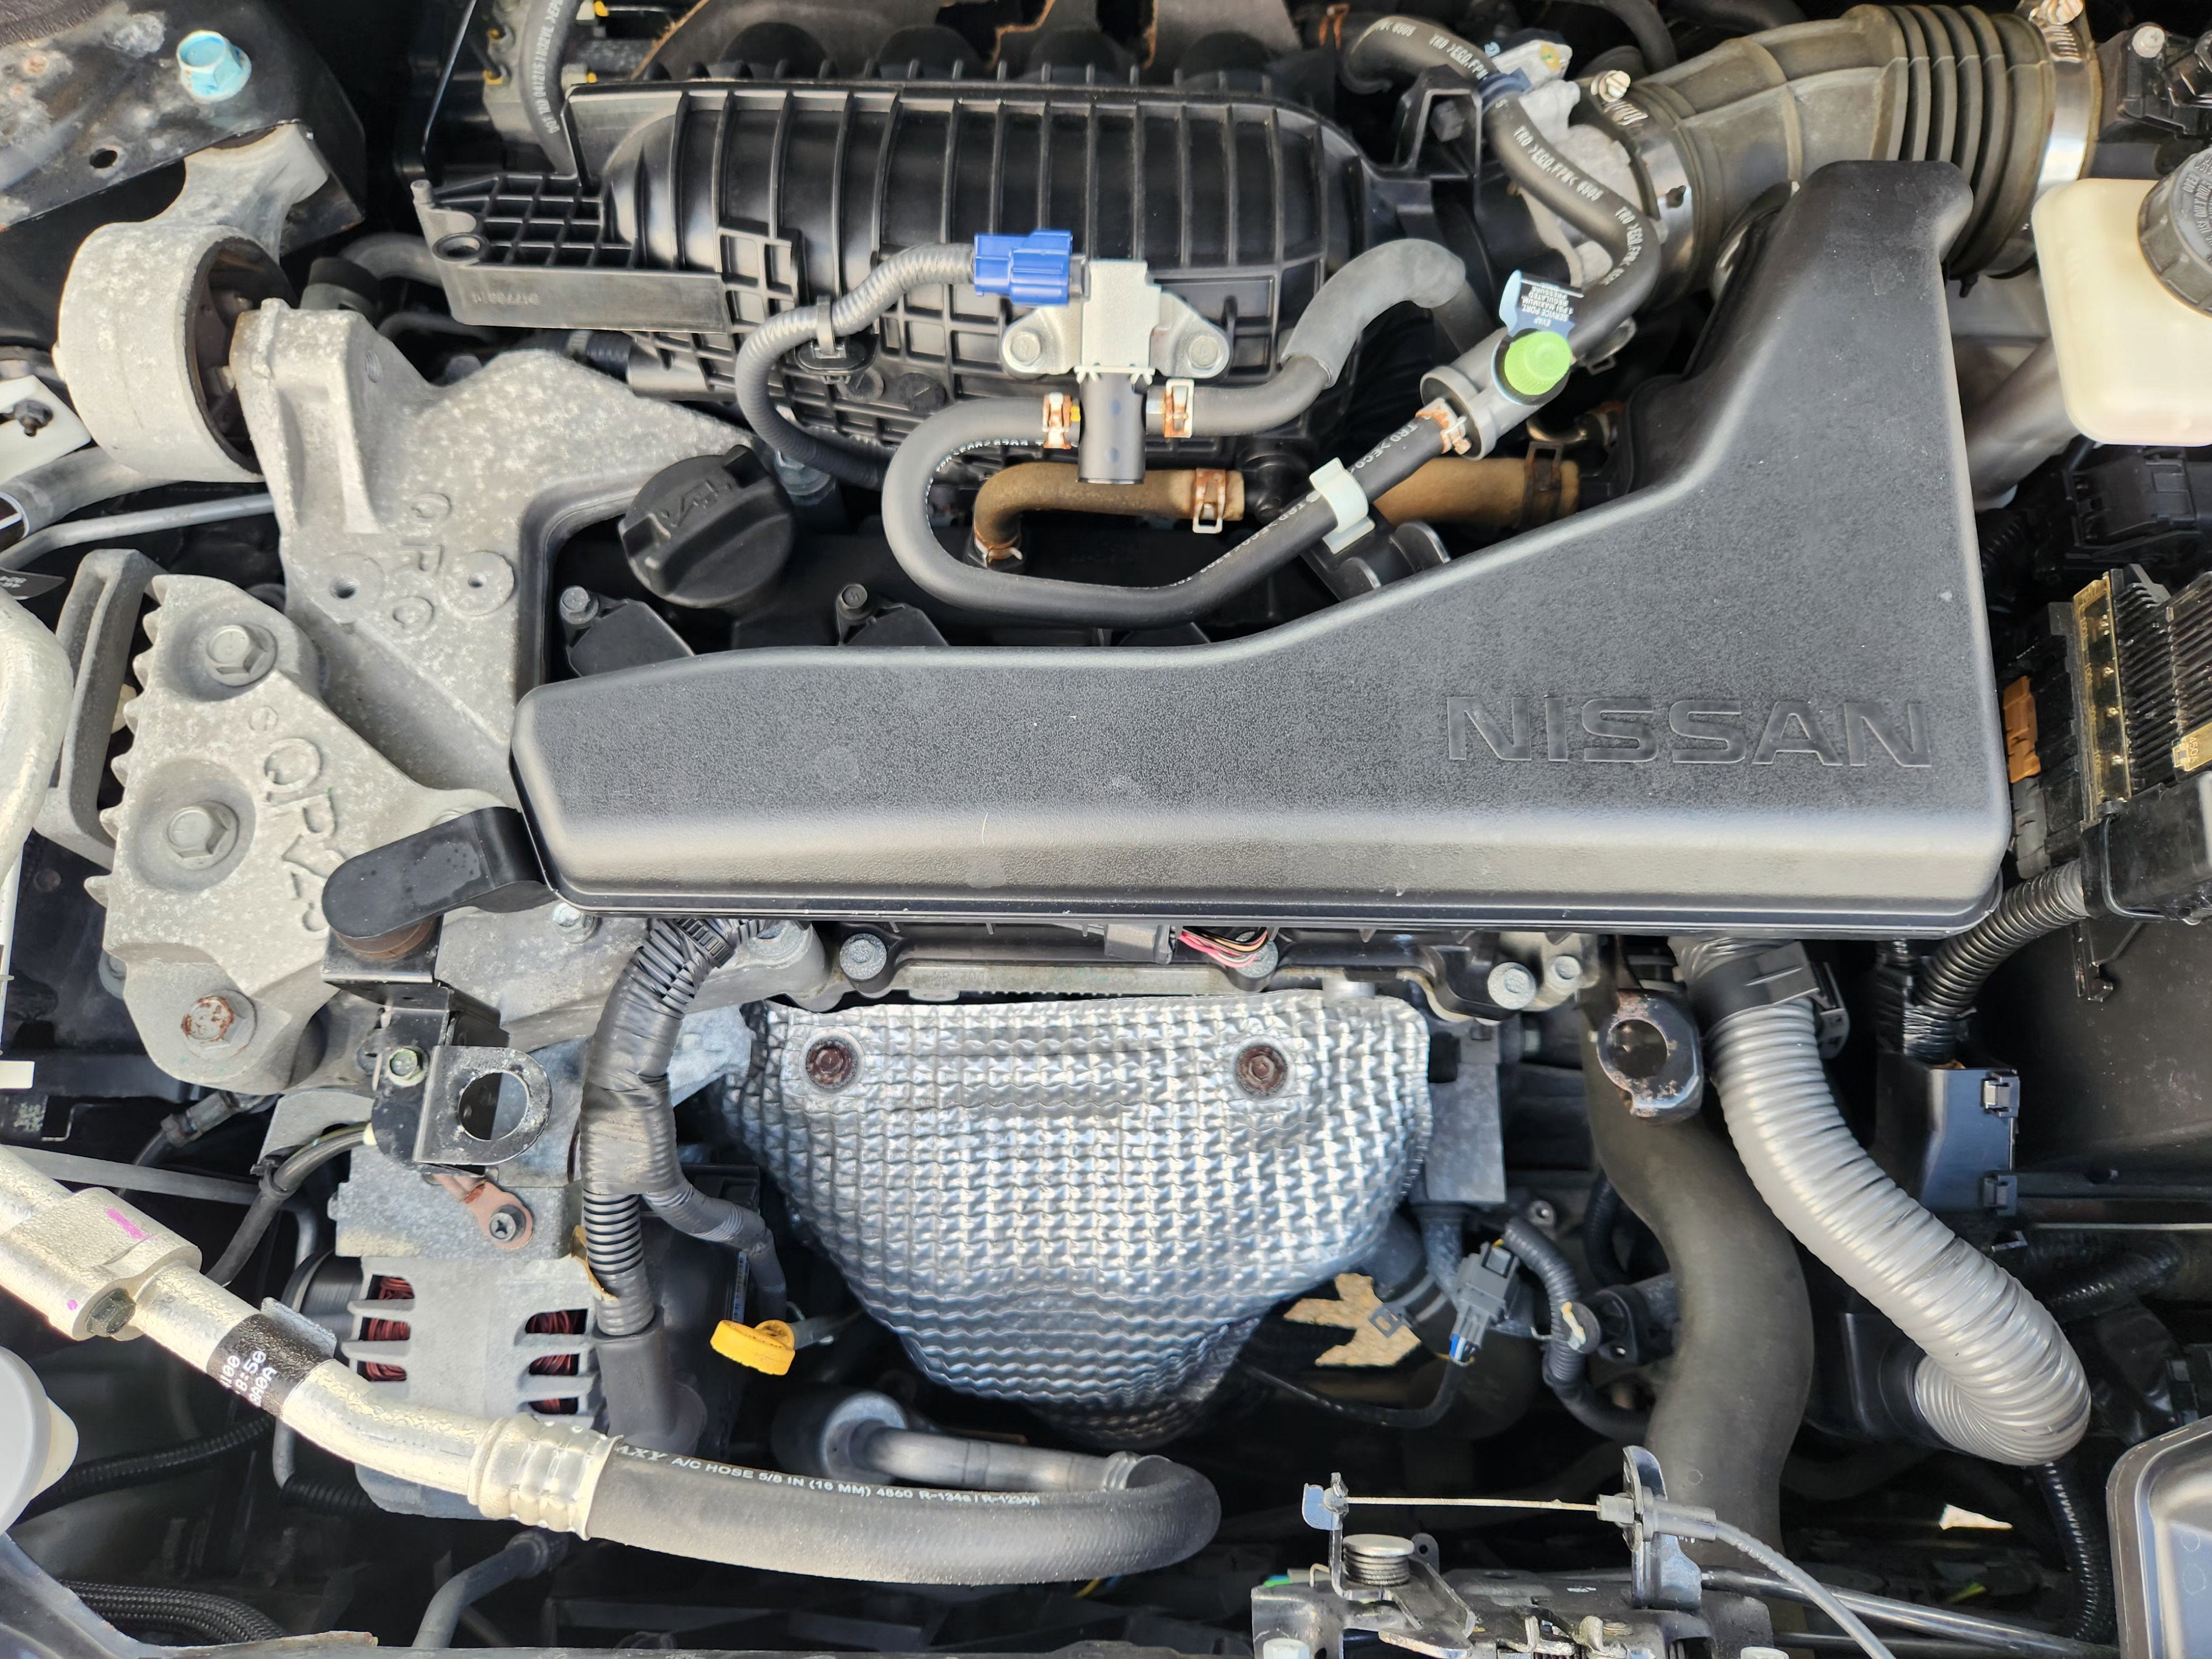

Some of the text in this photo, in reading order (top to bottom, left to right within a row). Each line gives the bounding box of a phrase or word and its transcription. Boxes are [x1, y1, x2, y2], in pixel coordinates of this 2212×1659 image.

[1541, 308, 1570, 322] SERVICE
[1389, 424, 1418, 442] TRD
[1447, 696, 1933, 768] NISSAN
[2188, 736, 2199, 764] 450A
[236, 1350, 267, 1394] 8:50
[671, 1457, 702, 1470] A/C
[705, 1463, 754, 1479] HOSE
[758, 1472, 783, 1484] 5/8
[787, 1476, 805, 1487] IN
[808, 1478, 833, 1490] (16
[838, 1483, 872, 1497] MM)
